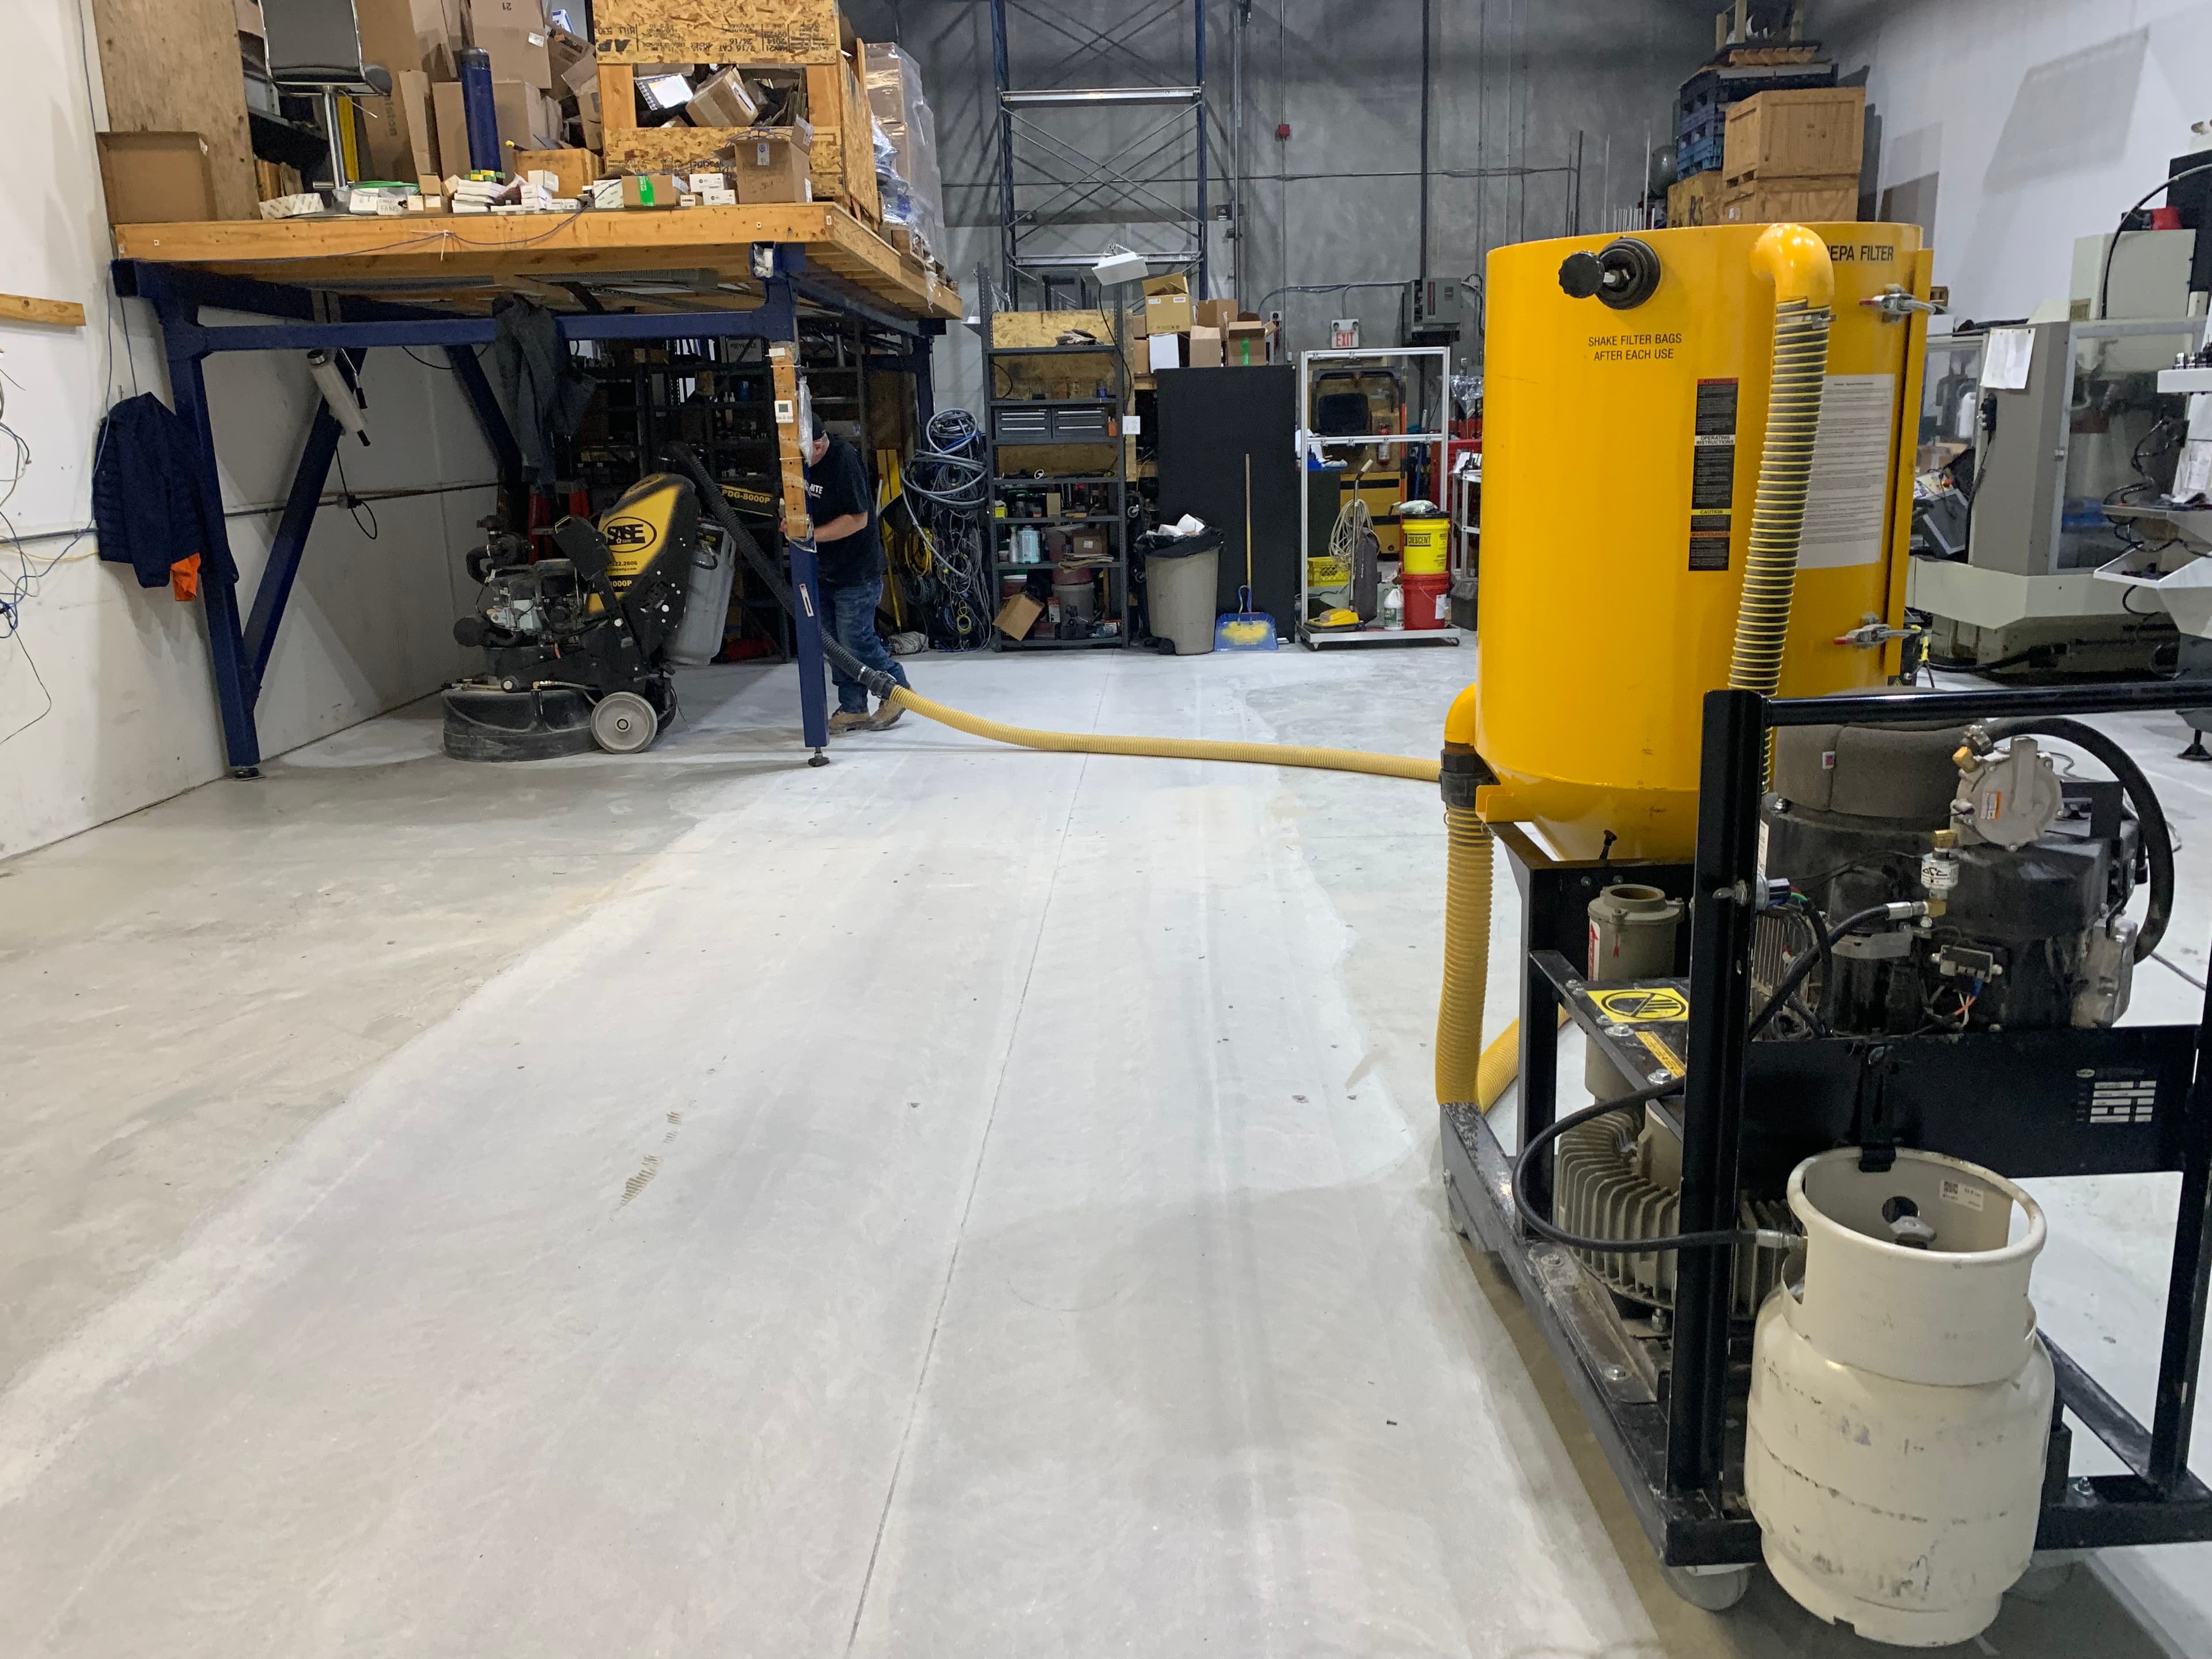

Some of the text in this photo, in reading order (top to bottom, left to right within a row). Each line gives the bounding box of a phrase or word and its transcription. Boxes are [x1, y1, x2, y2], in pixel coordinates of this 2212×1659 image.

[1860, 245, 1894, 261] FILTER
[1336, 331, 1354, 347] EXIT
[1588, 333, 1682, 346] SHAKE FILTER BAGS
[1593, 348, 1674, 361] AFTER EACH USE
[721, 489, 771, 504] PDG-8000P
[1408, 536, 1431, 544] CRESCENT
[611, 579, 632, 588] 000P
